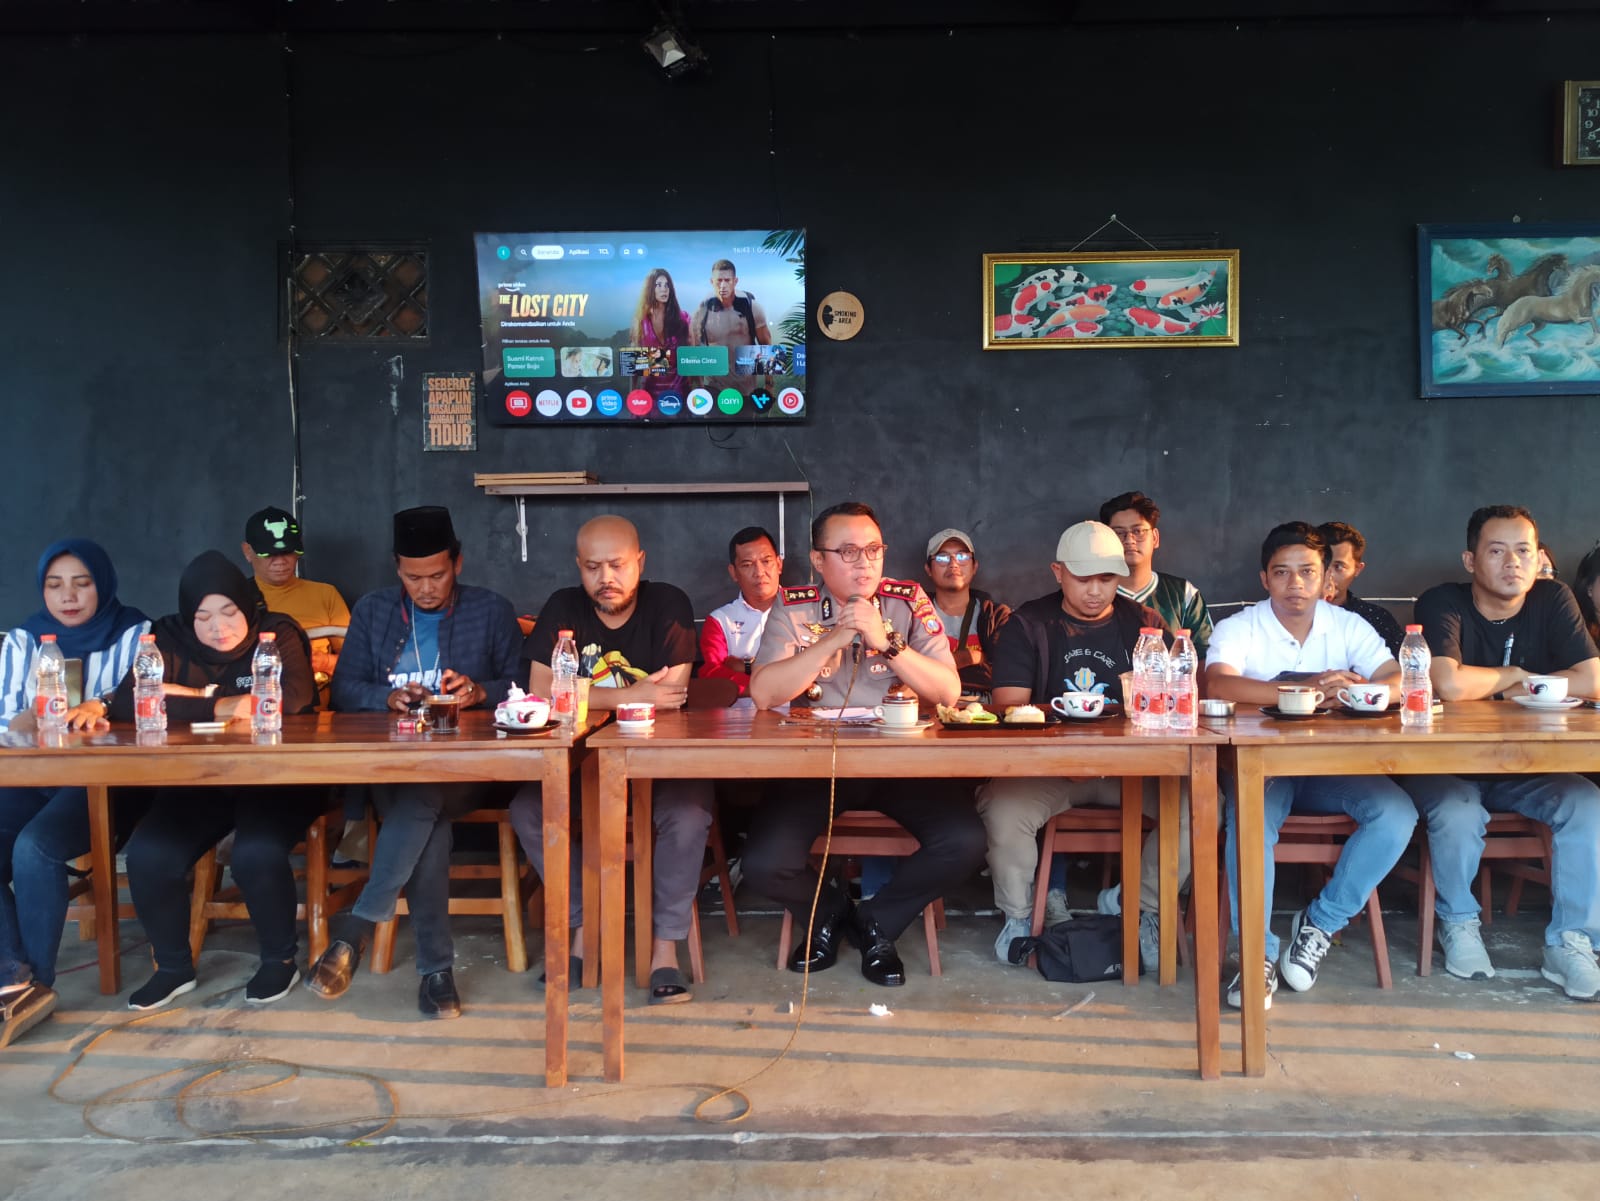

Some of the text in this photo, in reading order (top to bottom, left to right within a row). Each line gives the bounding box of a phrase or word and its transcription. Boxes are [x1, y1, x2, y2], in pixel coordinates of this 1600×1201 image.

[1587, 108, 1599, 117] 10
[1584, 120, 1593, 129] 9
[1587, 131, 1597, 140] 8
[499, 293, 588, 317] THE LOST CITY
[428, 378, 471, 390] SEBERAT
[428, 391, 472, 404] APAPUN
[429, 424, 472, 446] TIDUR
[1093, 650, 1116, 668] CARE
